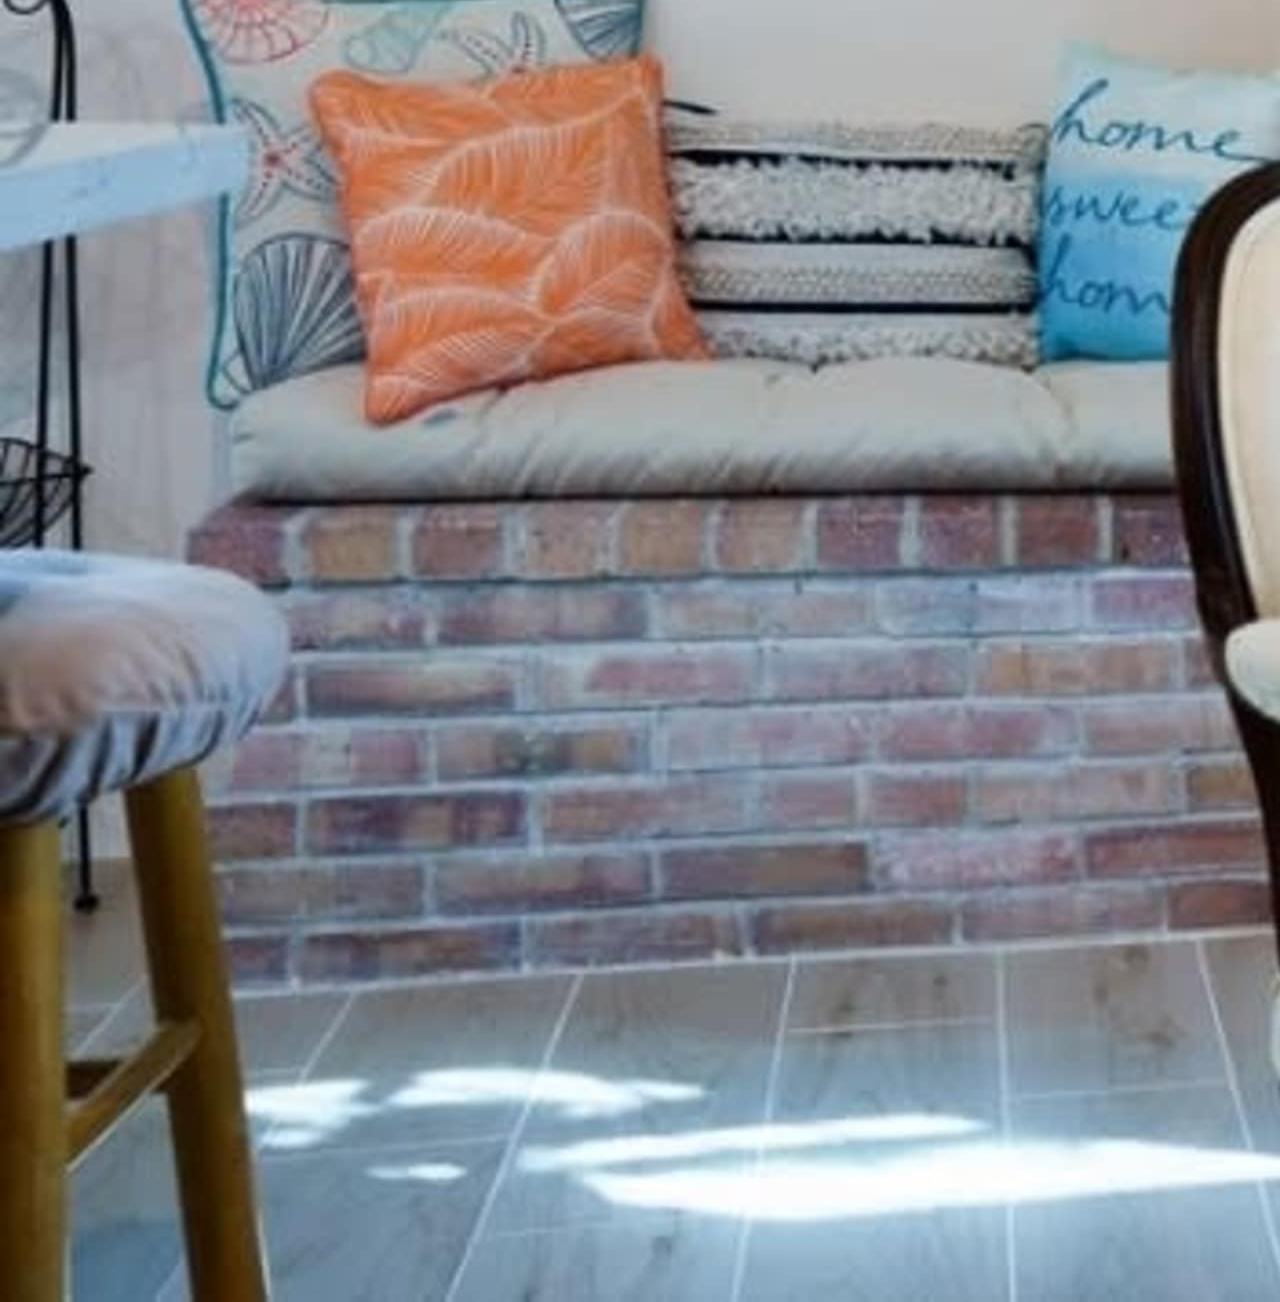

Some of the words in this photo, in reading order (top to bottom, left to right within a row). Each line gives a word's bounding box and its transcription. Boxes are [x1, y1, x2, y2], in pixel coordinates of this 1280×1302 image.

[1050, 78, 1274, 163] home
[1048, 185, 1188, 231] swee
[1044, 232, 1170, 316] hom
